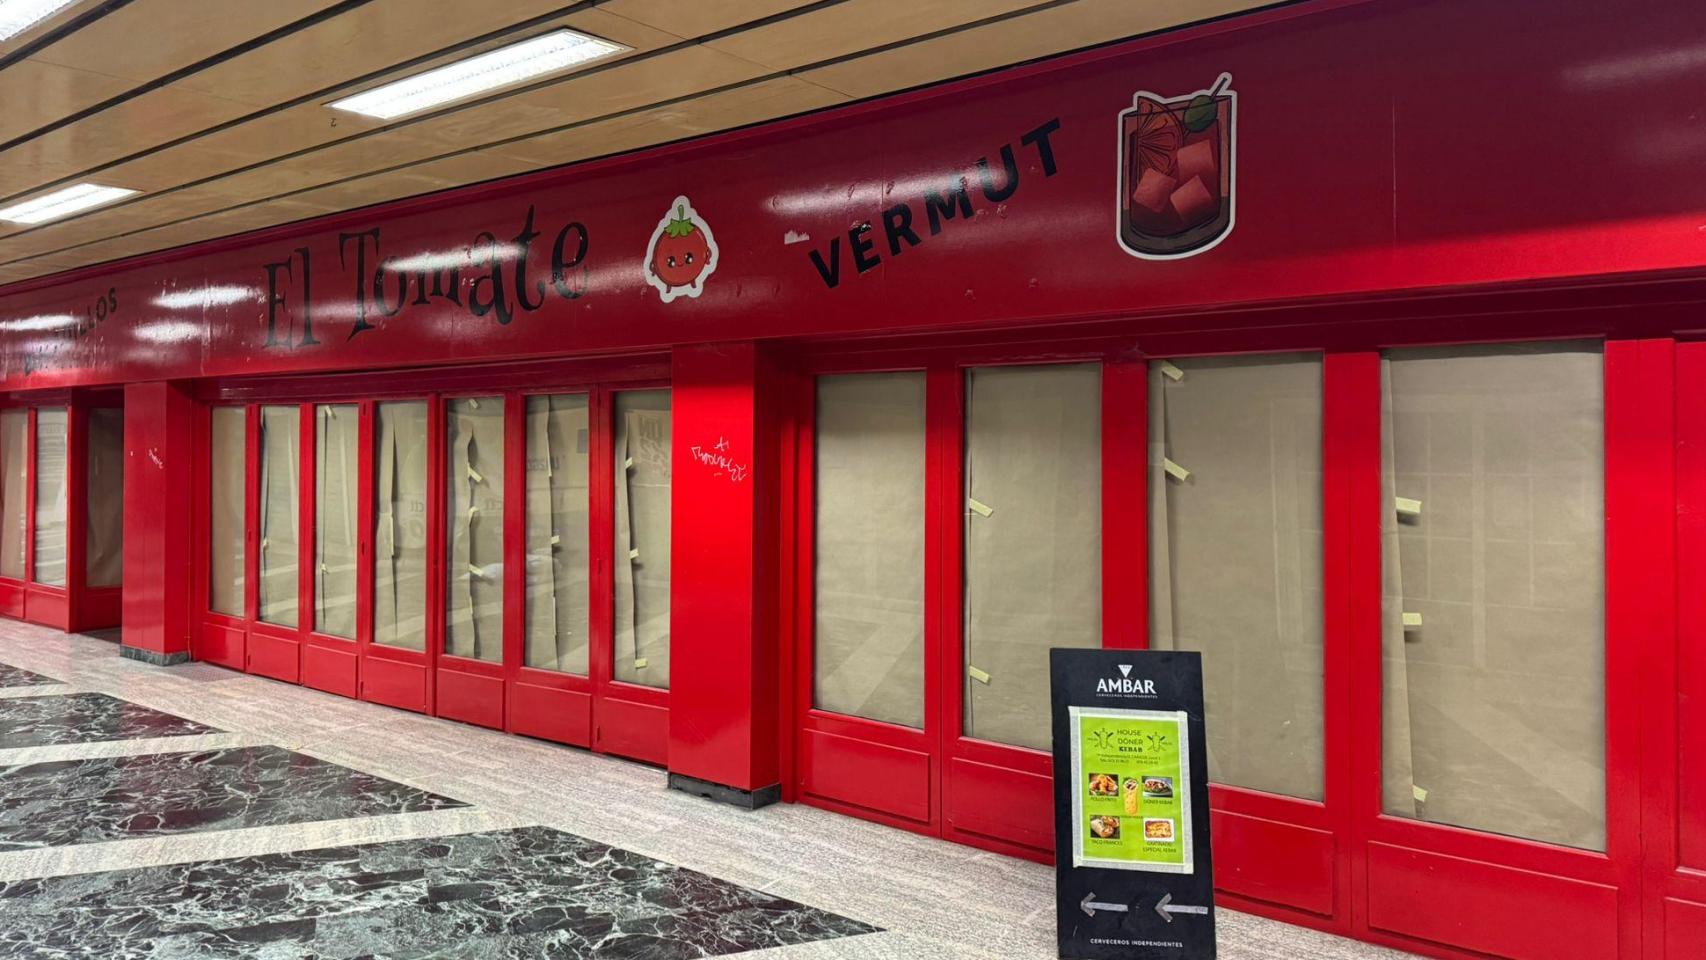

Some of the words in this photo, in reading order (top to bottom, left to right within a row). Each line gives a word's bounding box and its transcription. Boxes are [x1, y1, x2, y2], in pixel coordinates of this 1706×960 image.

[808, 117, 1061, 290] VERMUT
[262, 246, 321, 350] El
[338, 203, 589, 342] Tomate
[1096, 678, 1157, 694] AMBAR
[1090, 938, 1130, 946] CERVECEROS
[1131, 939, 1183, 948] INDEPENDIENTES
